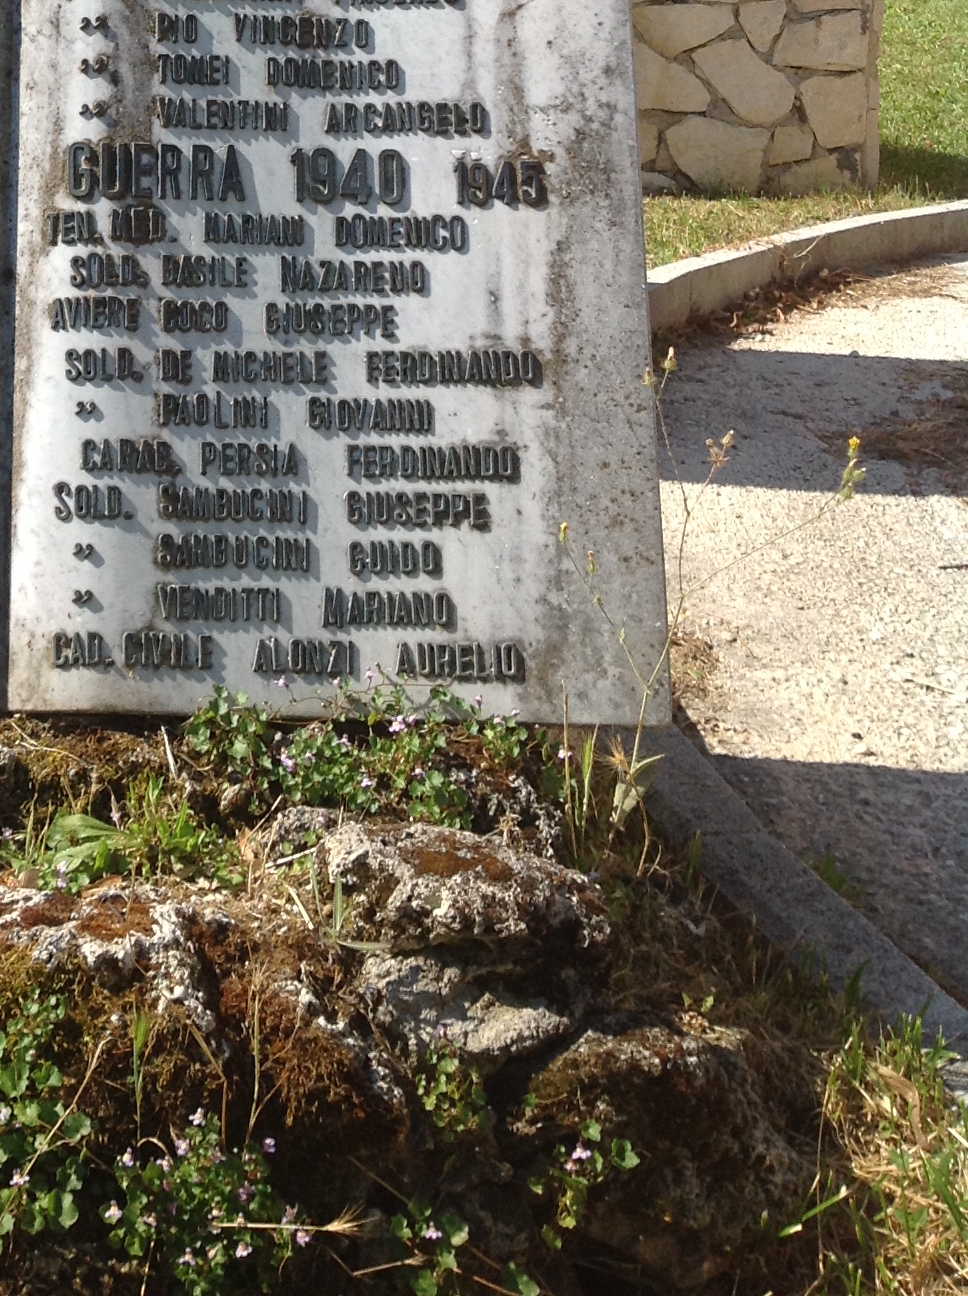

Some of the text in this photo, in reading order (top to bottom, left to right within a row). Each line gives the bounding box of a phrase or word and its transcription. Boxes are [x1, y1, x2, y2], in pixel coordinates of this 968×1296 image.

[156, 12, 198, 43] PIO
[234, 12, 370, 49] VINCENZO
[158, 54, 230, 86] TOMEI
[266, 57, 399, 90] DOMENICO
[156, 96, 289, 131] VALENTINI
[324, 101, 484, 134] ARCANGELO
[68, 141, 549, 206] GUERRA 1940 1945
[203, 211, 305, 247] MARIANI
[335, 213, 467, 251] DOMENICO
[161, 254, 248, 288] BASILE
[280, 256, 426, 294] NAZARENO
[51, 296, 398, 338] AVIERE COCO GIUSEPPE
[159, 348, 193, 383] DE
[212, 350, 328, 385] MICHELE
[365, 349, 534, 385] FERDINANDO
[159, 391, 269, 429] PAOLINI
[307, 395, 431, 432] GIOVANNI
[200, 441, 299, 477] PERSIA
[345, 443, 515, 479] FERDINANDO
[158, 482, 308, 525] SAMBUCINI
[344, 490, 489, 527] GIUSEPPE
[156, 533, 310, 572] SAMBUCINI
[348, 540, 437, 575] GUIDO
[157, 583, 281, 622] VENDITTI
[322, 586, 450, 629] MARIANO
[122, 631, 213, 669] CIVILE
